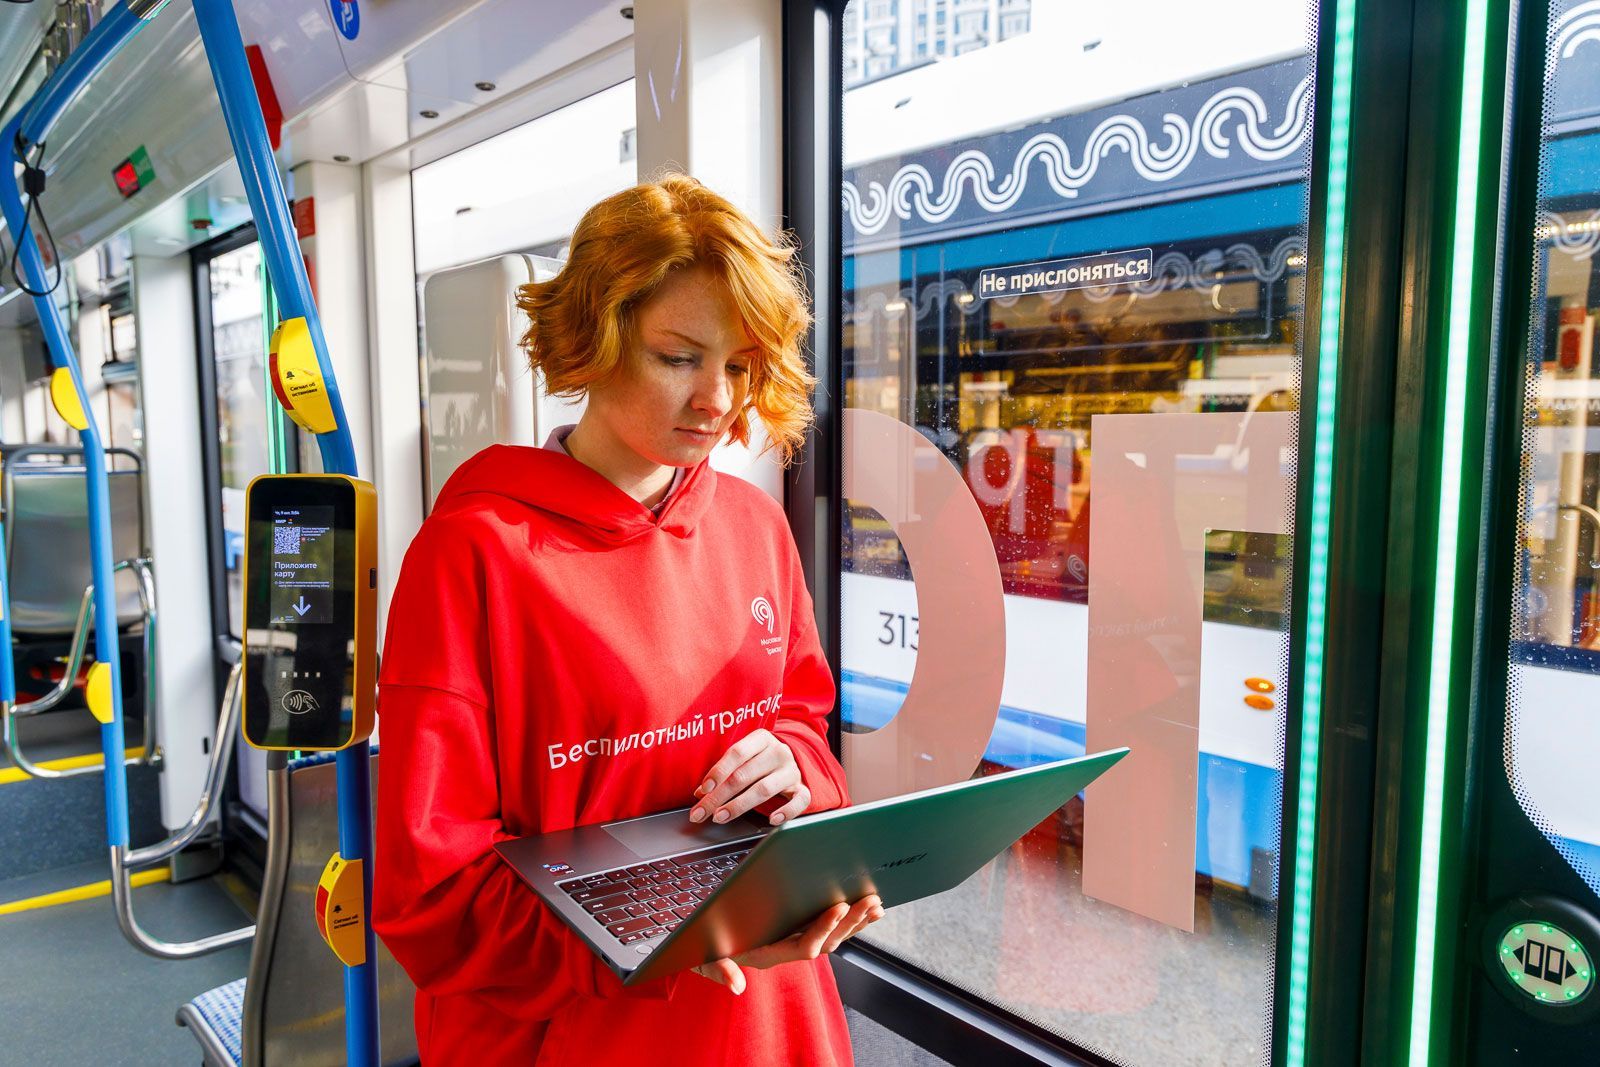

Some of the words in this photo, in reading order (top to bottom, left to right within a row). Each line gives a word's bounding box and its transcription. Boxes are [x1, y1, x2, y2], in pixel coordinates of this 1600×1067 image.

[982, 273, 1007, 293] Не
[1010, 258, 1149, 292] прислоняться
[274, 561, 318, 570] Приложите
[547, 713, 704, 770] Беспилотный
